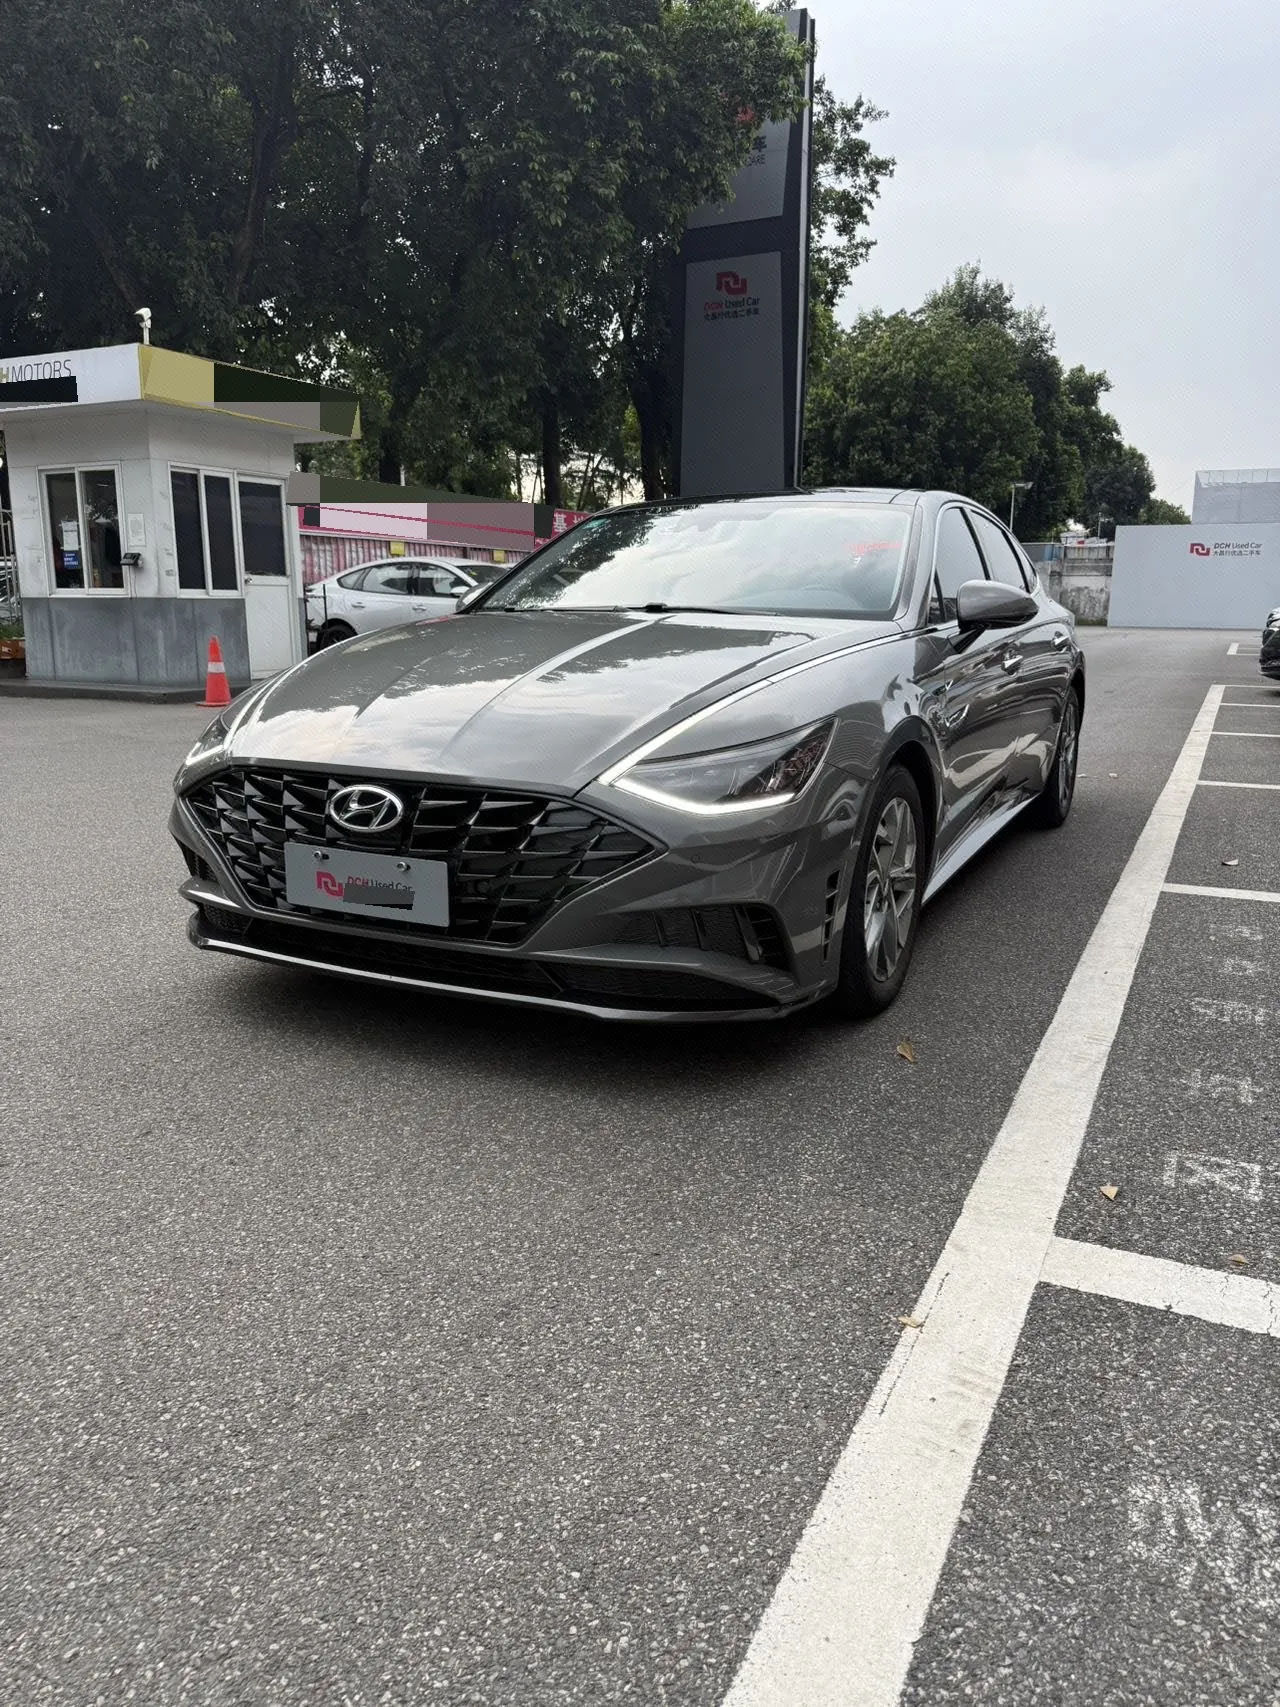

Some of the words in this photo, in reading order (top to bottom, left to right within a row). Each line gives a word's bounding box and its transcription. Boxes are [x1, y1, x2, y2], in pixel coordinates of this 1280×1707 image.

[724, 298, 745, 309] Used
[746, 296, 761, 306] Car
[1232, 541, 1249, 549] Used
[370, 879, 394, 890] Used
[395, 882, 413, 892] Car
